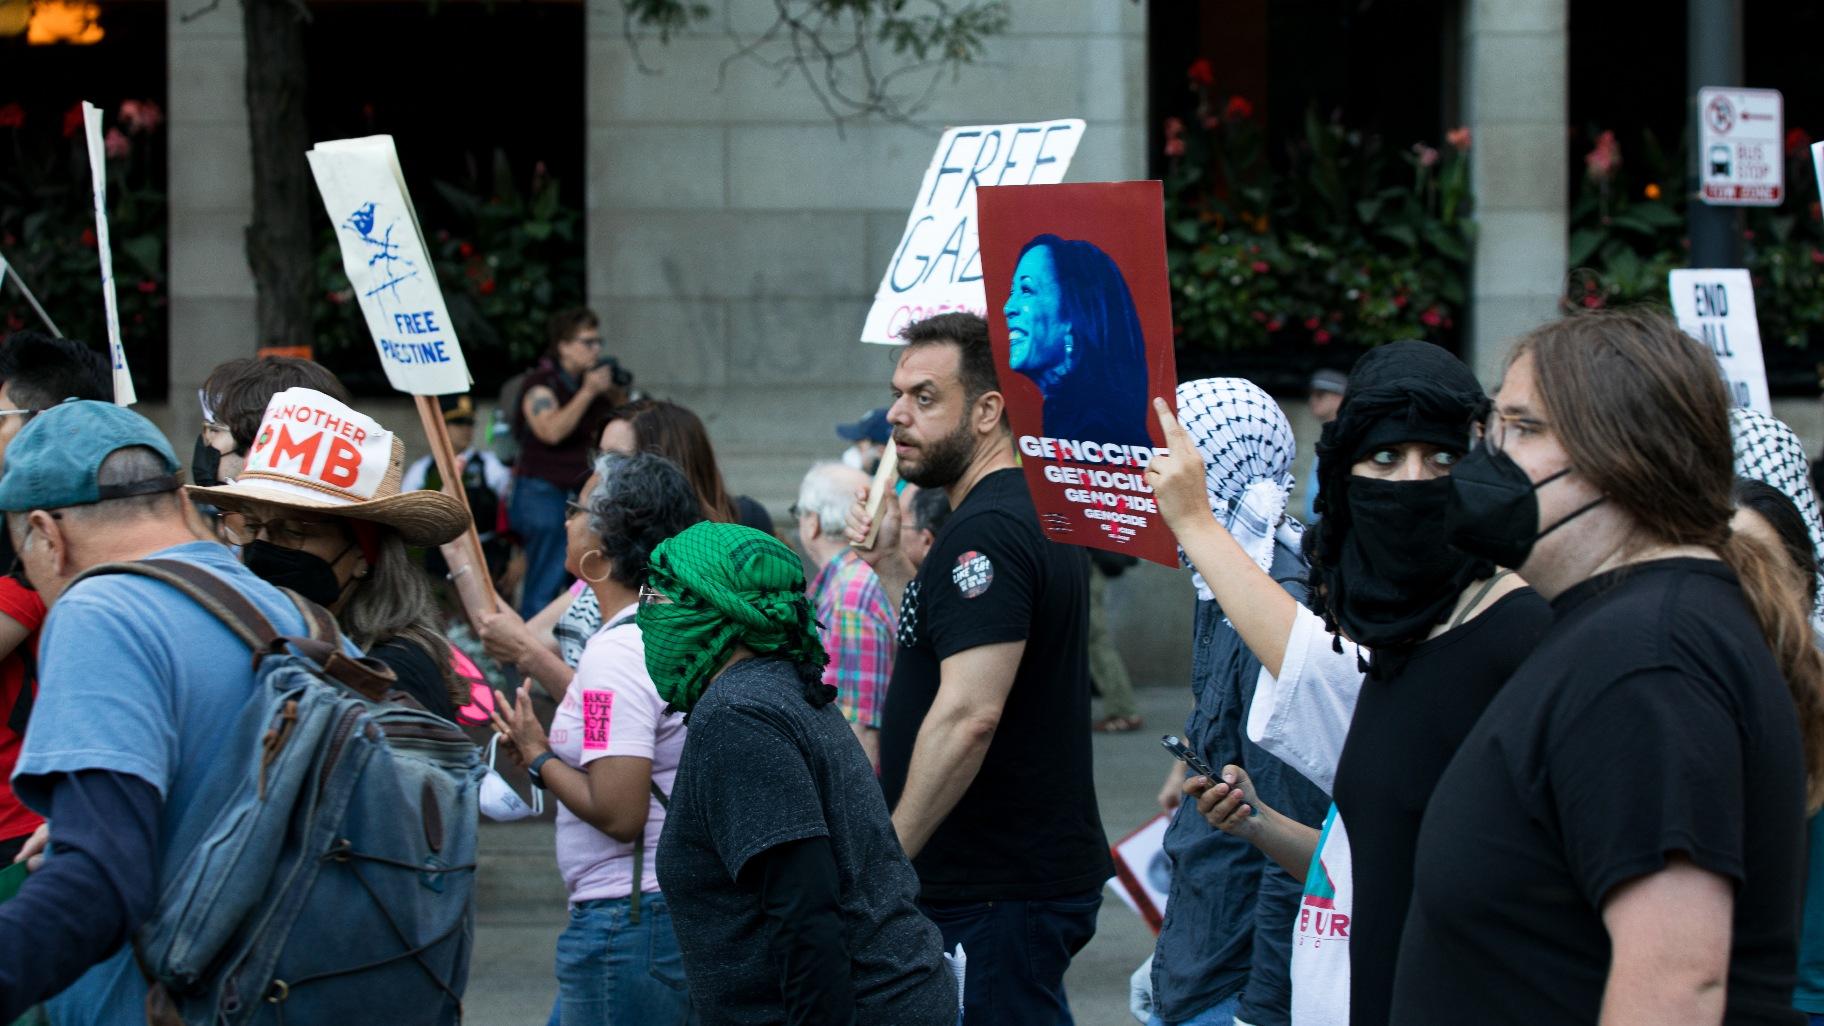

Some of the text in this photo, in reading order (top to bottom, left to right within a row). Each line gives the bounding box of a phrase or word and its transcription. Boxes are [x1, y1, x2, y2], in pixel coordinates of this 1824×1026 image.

[1736, 145, 1763, 160] BUS
[1737, 162, 1769, 178] STOP
[890, 215, 984, 292] GAZ
[1694, 283, 1728, 317] END
[394, 310, 439, 334] FREE
[1043, 465, 1153, 494] GENOCID
[1084, 508, 1147, 528] GENOCIDE
